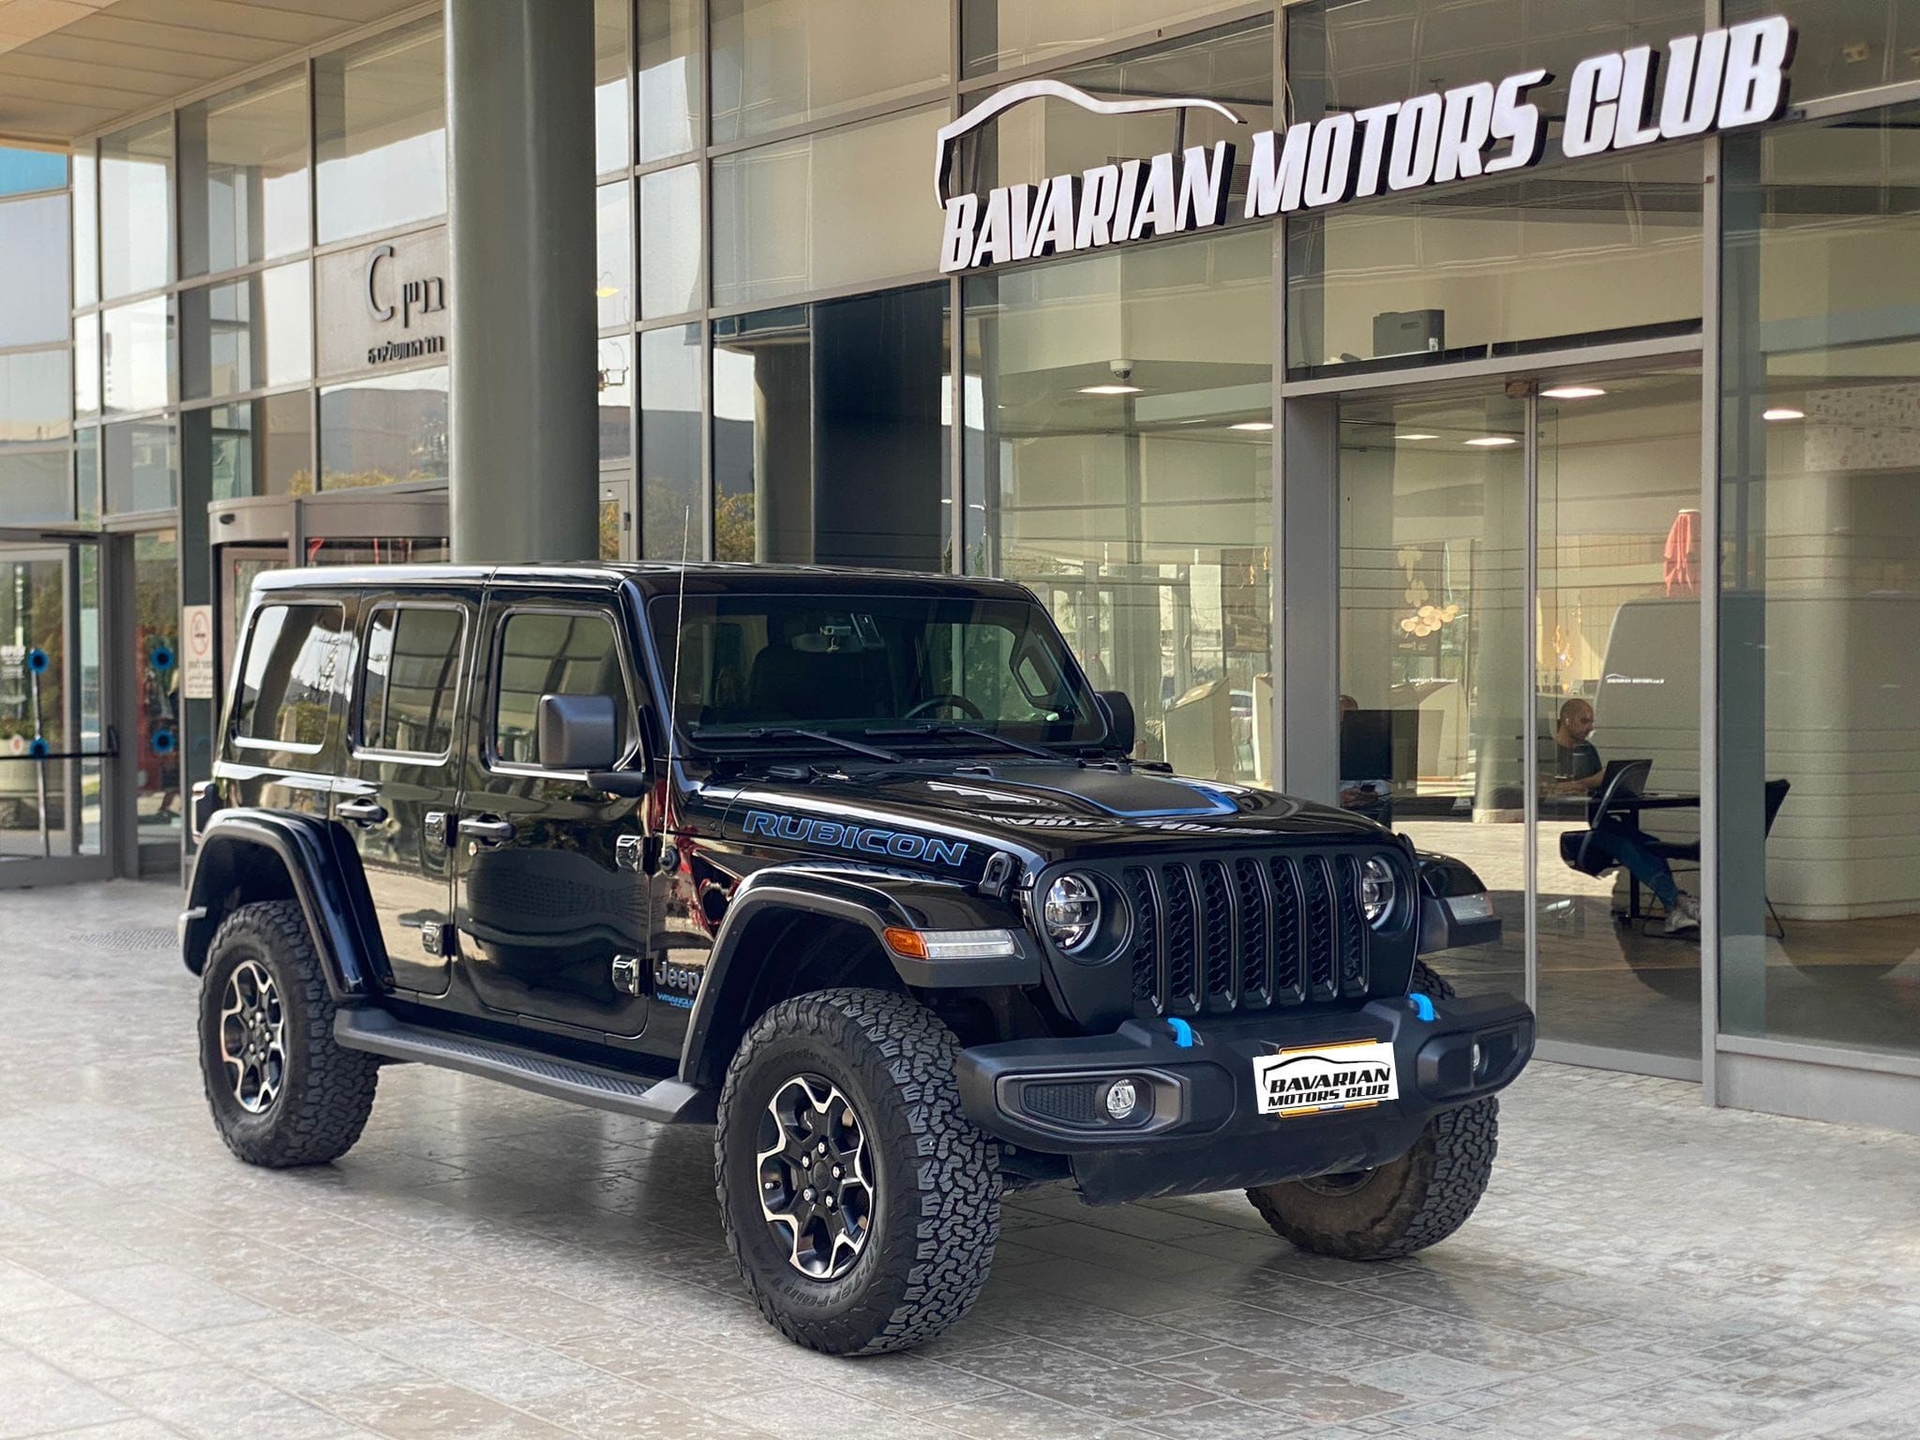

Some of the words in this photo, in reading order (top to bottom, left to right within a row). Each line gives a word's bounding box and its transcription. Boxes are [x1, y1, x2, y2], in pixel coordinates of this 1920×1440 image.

[940, 141, 1232, 273] BAVARIAN
[1244, 68, 1550, 219] MOTORS
[1562, 15, 1793, 158] CLUB
[365, 245, 394, 322] C
[402, 276, 445, 328] בניין
[742, 810, 968, 867] RUBICON
[655, 961, 700, 995] Jeep
[1268, 1088, 1341, 1107] MOTORS
[1345, 1084, 1390, 1099] CLUB
[1270, 1067, 1391, 1094] BAVARIAN
